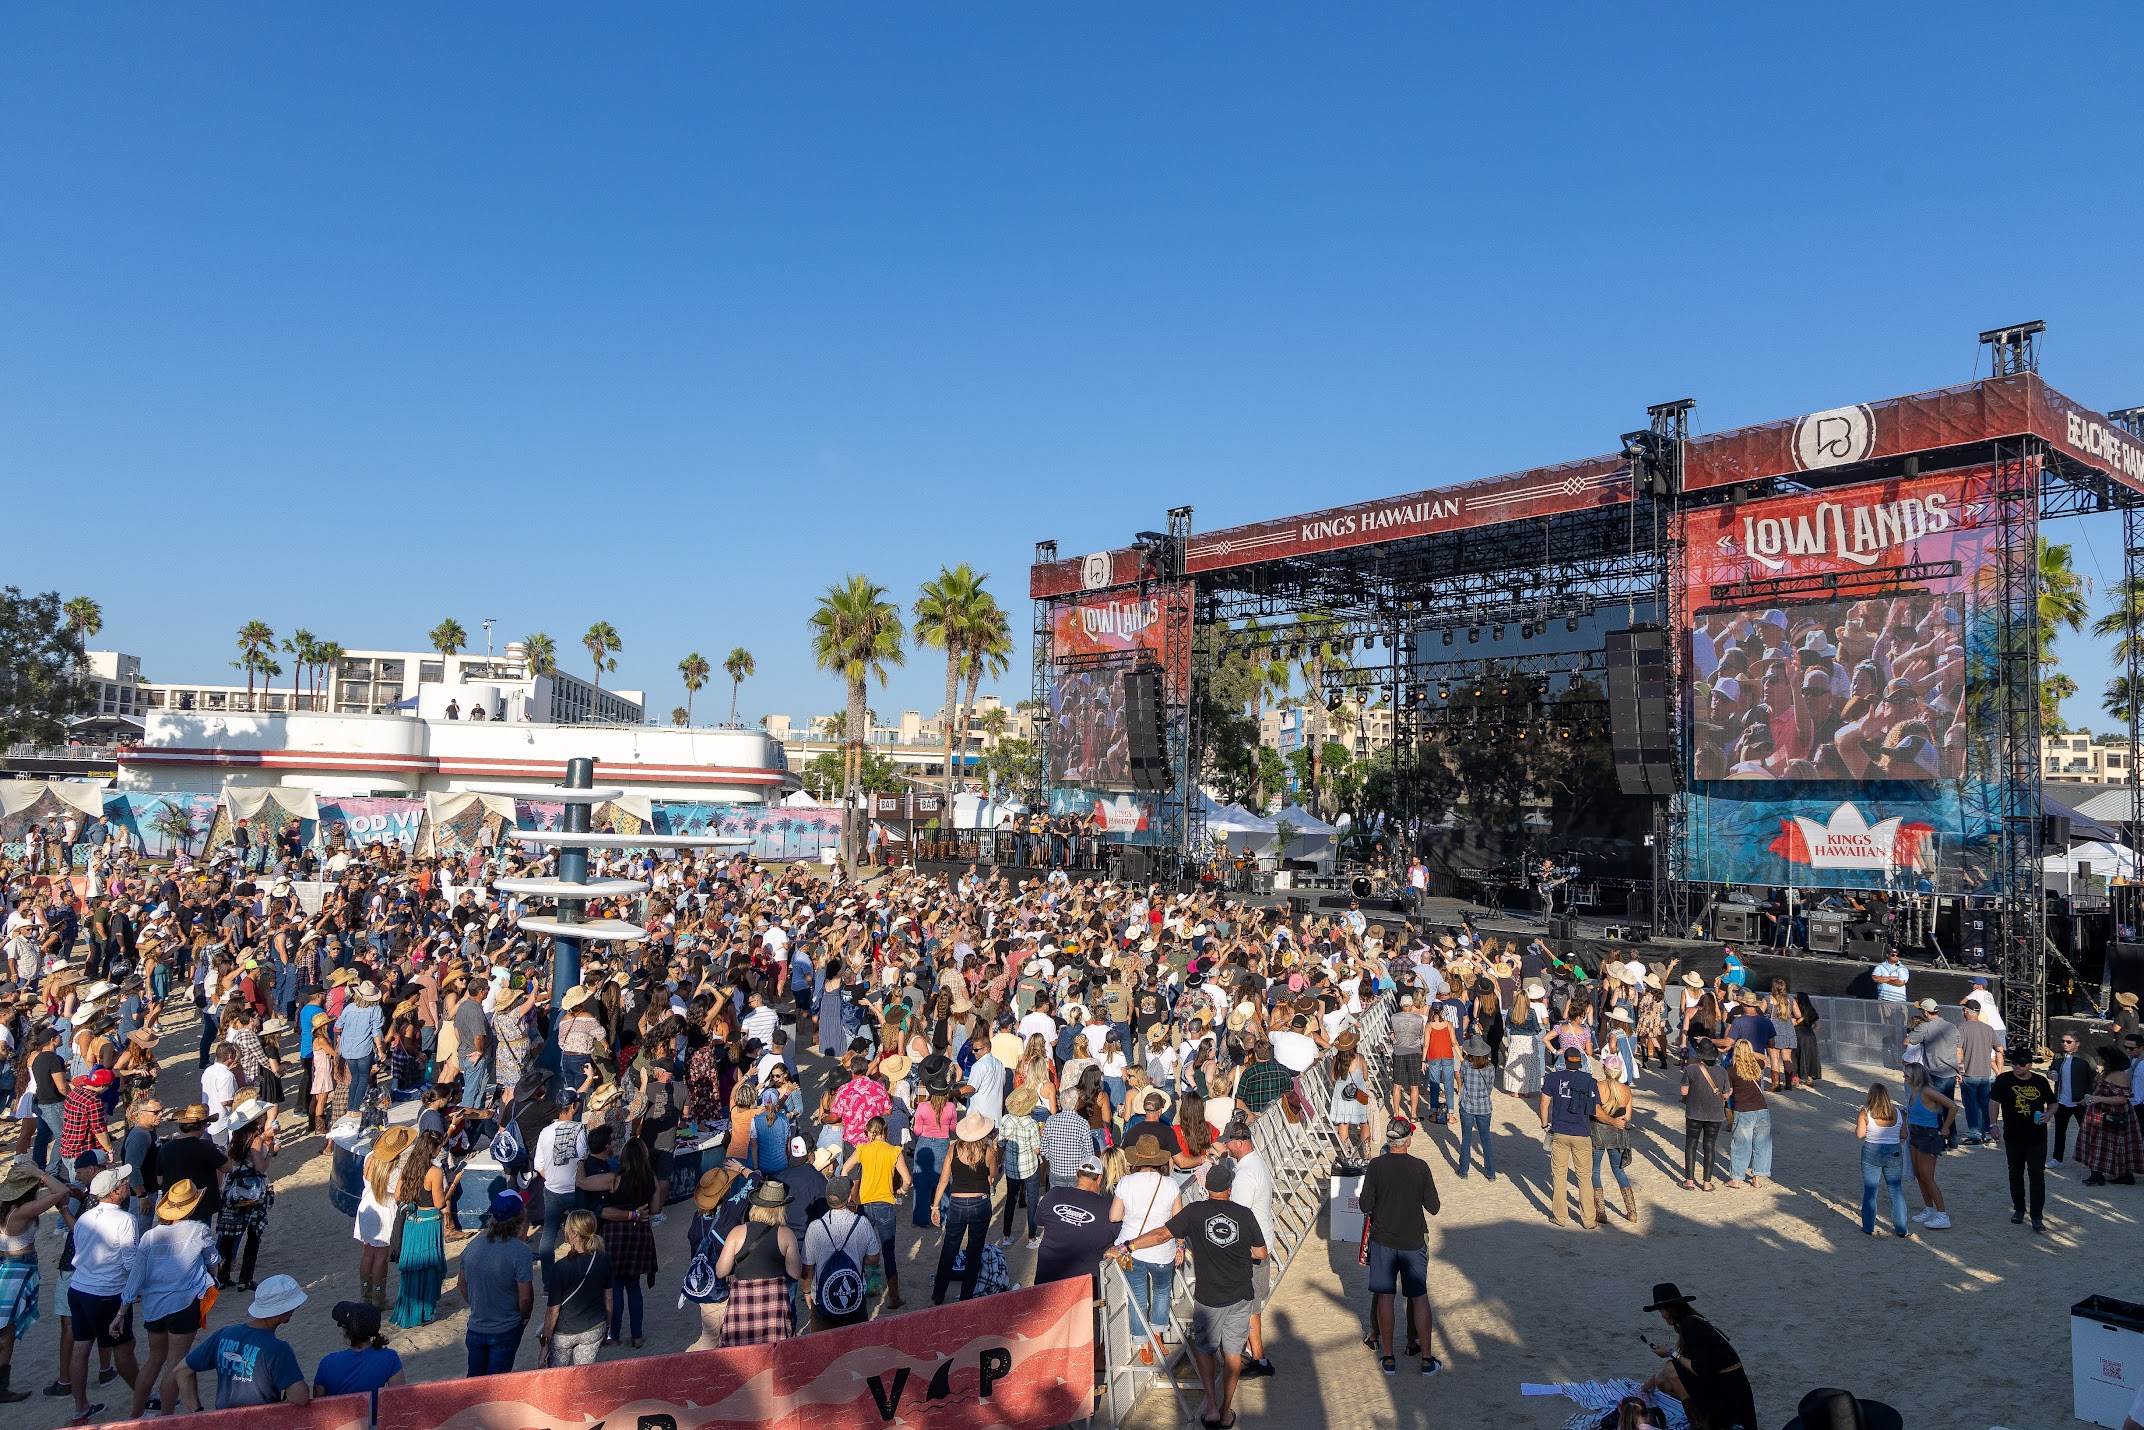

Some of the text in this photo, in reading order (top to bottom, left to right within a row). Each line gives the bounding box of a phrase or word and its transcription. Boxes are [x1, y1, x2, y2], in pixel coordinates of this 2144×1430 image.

[1301, 497, 1460, 542] KING'S HAWAIIAN
[1744, 493, 1950, 570] LOWLANDS
[1080, 598, 1160, 642] LOWLANDS
[881, 800, 894, 809] BAR
[921, 800, 936, 810] BAR
[1827, 833, 1872, 846] KING'S
[1815, 846, 1886, 858] HAWAIIAN
